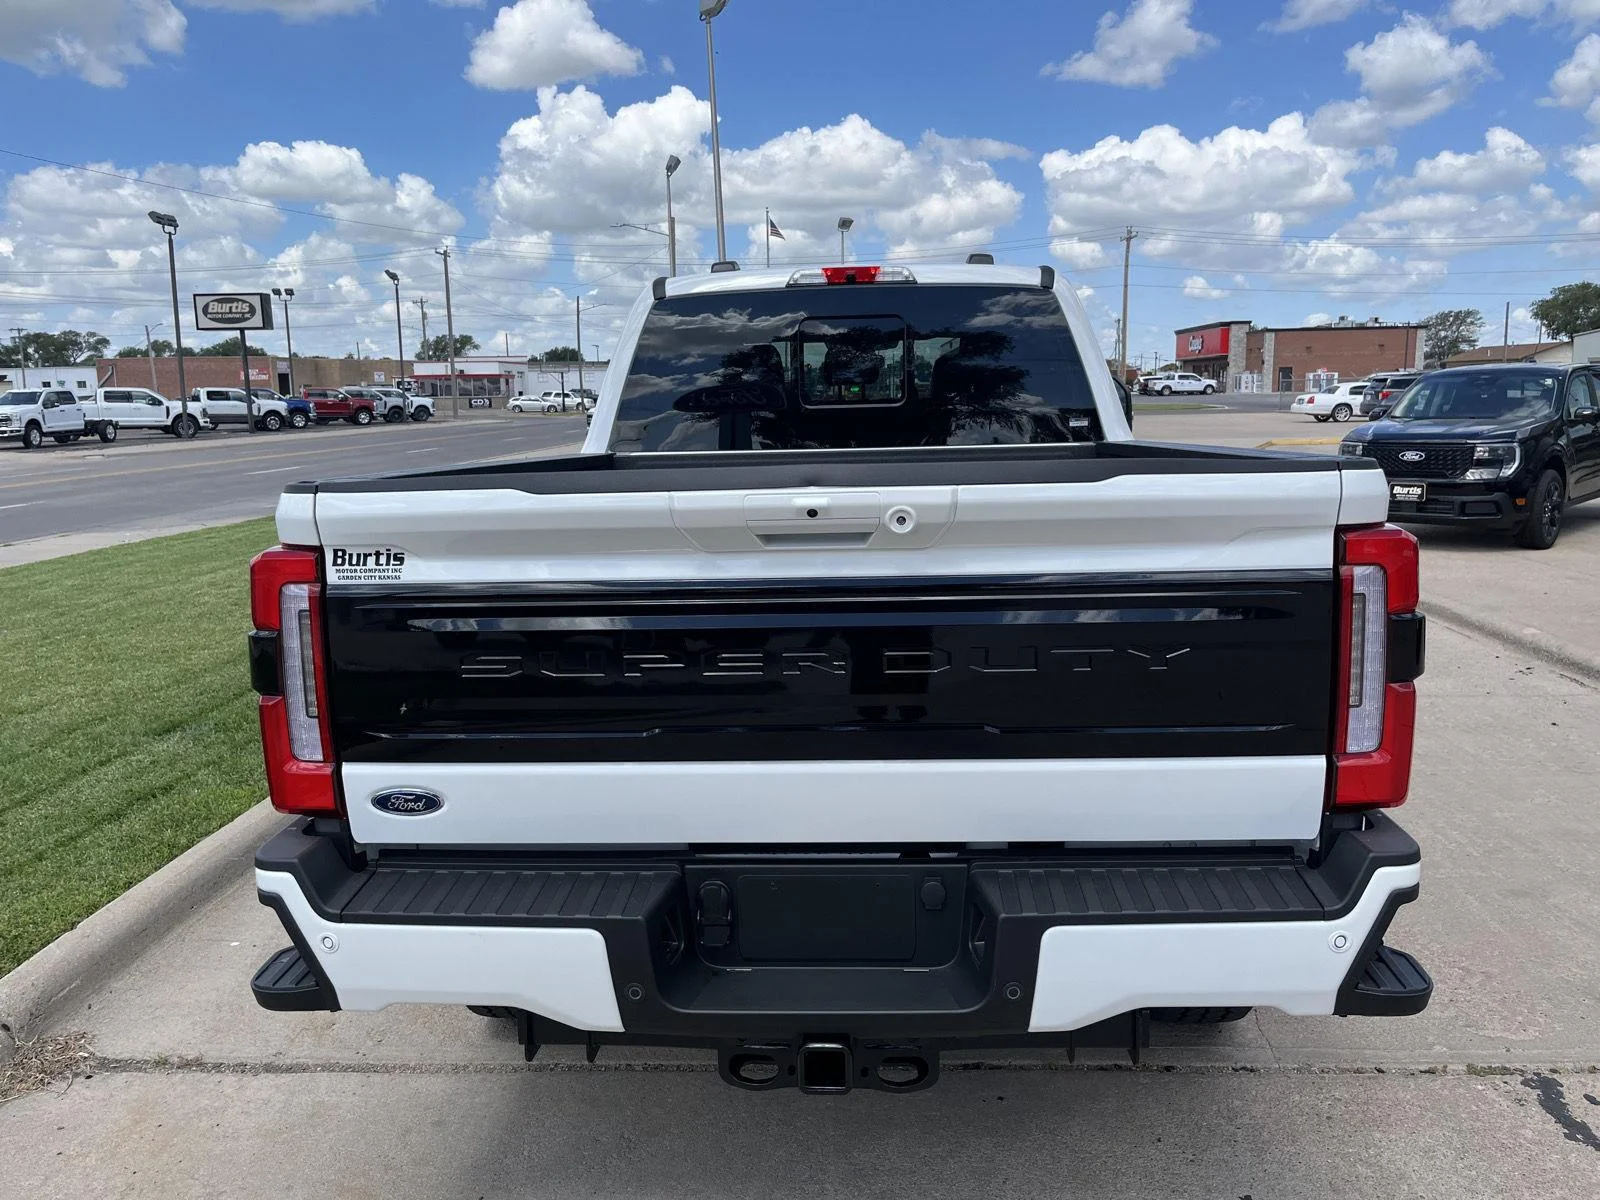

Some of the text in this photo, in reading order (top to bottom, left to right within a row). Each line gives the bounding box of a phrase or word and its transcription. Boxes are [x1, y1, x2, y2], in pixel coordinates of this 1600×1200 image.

[207, 301, 250, 313] Burtis
[1393, 486, 1422, 494] Burtis
[332, 548, 405, 567] Burtis
[460, 645, 1192, 679] SUPER DUTY
[387, 794, 426, 810] Ford
